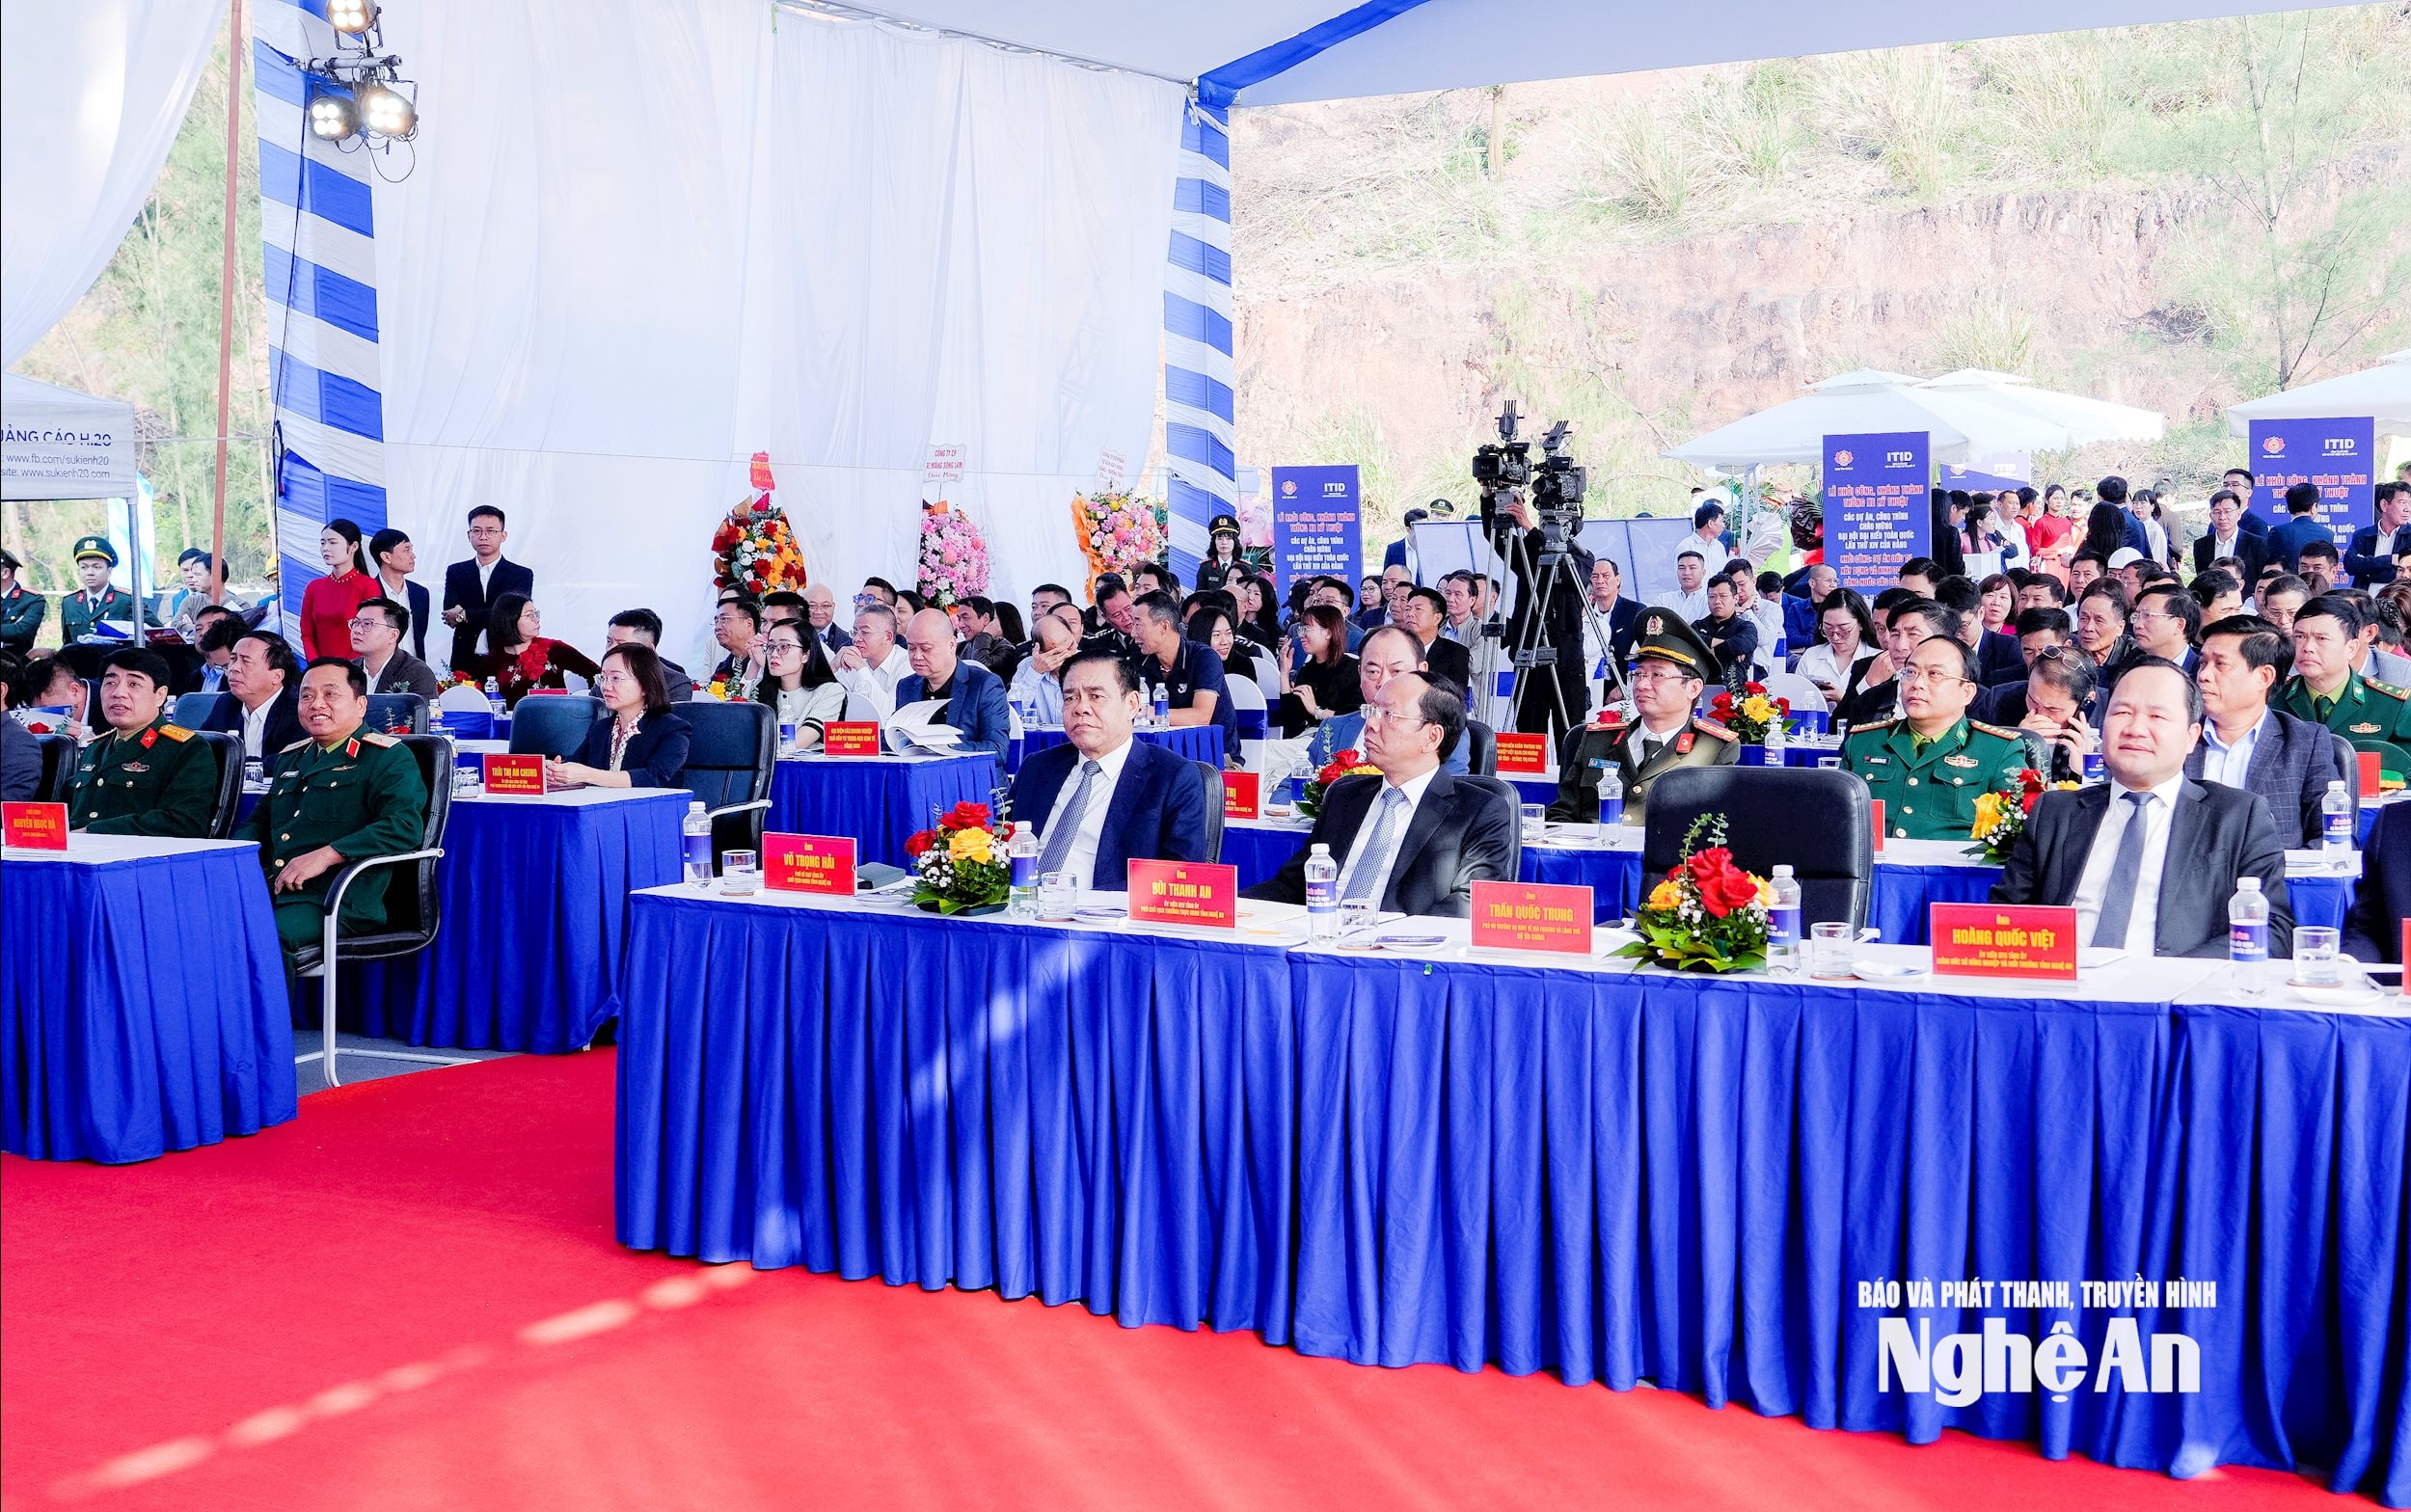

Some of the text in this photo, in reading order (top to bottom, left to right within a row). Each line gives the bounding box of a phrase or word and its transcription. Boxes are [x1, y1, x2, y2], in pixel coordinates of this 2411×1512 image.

[2325, 439, 2355, 449] ITID
[1887, 451, 1912, 462] ITID
[2255, 474, 2264, 486] LỄ
[2266, 473, 2285, 486] KHỞI
[2313, 473, 2339, 485] KHÁNH
[2341, 472, 2367, 485] THÀNH
[1323, 482, 1346, 492] ITID
[2324, 486, 2349, 500] THUẬT
[2273, 503, 2286, 513] CÁC
[2330, 503, 2348, 513] TRÌNH
[2338, 523, 2355, 533] QUỐC
[2333, 534, 2346, 543] ẢNG
[784, 851, 835, 870] VÕ TRỌNG HẢI
[1152, 879, 1211, 899] BÙI THANH AN
[1489, 903, 1574, 922] TRẦN QUỐC TRUNG
[1953, 926, 2056, 951] HOÀNG QUỐC VIỆT
